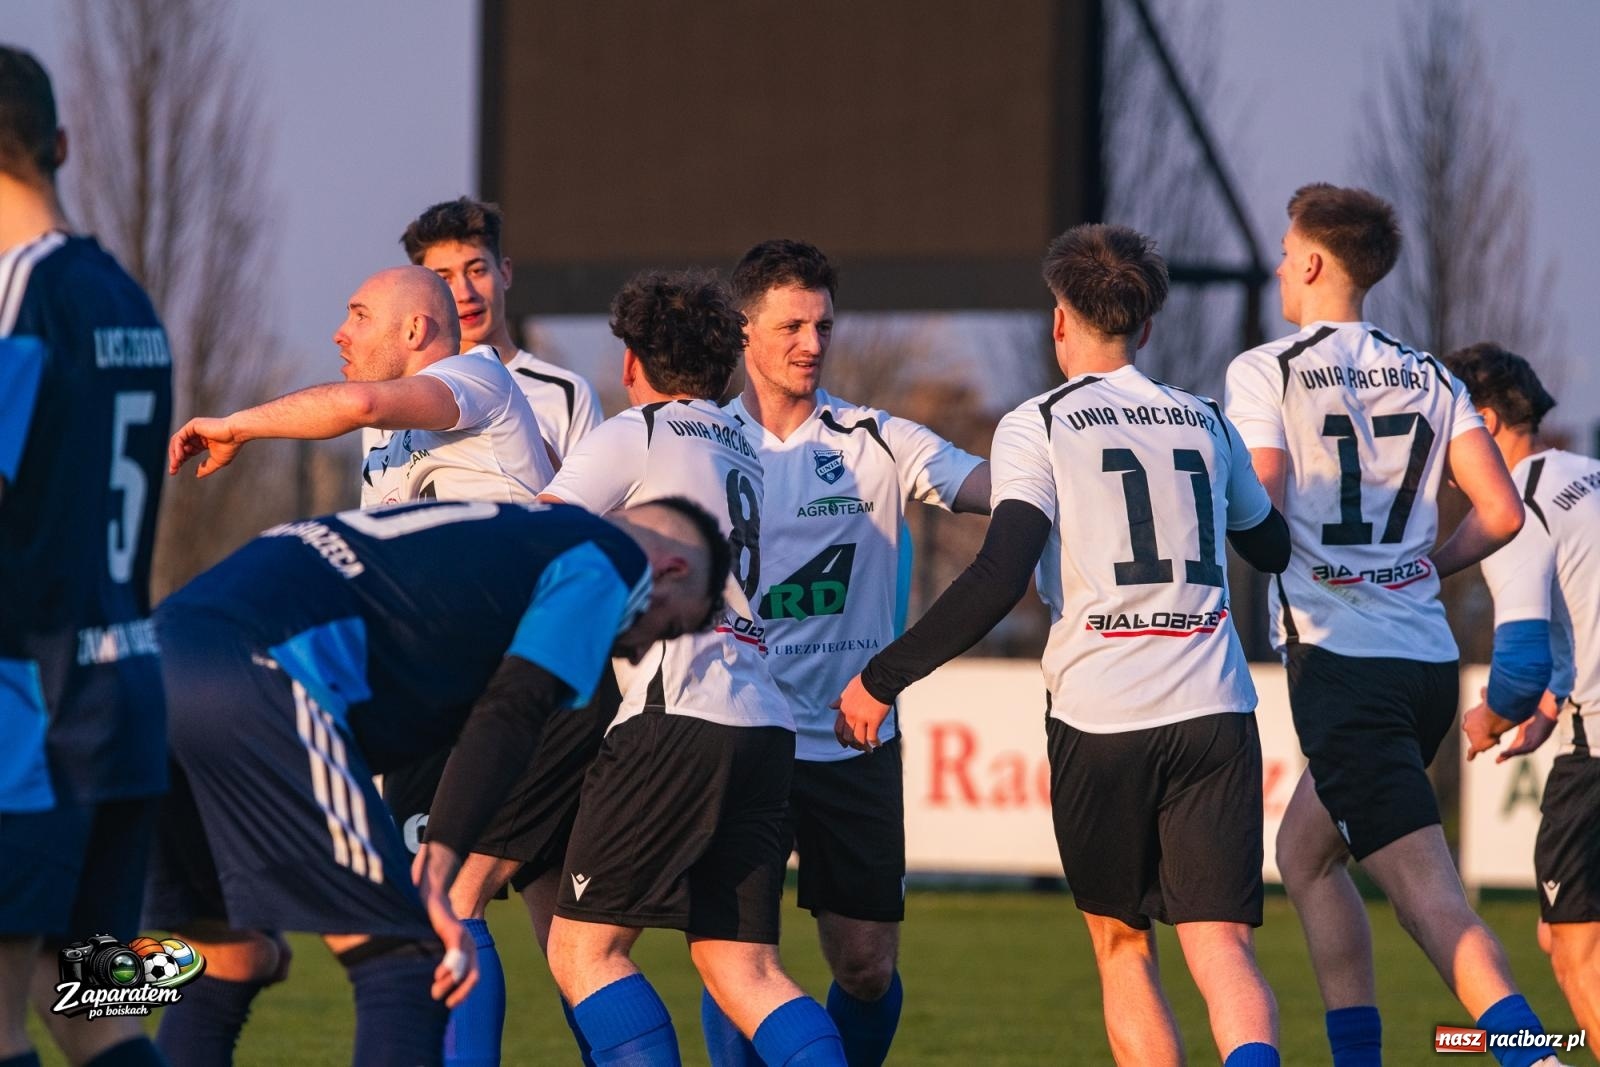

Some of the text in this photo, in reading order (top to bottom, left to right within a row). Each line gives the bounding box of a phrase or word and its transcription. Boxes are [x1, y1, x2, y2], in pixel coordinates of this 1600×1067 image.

[1300, 364, 1429, 393] UNIA RACIBÓRZ
[666, 420, 712, 440] UNIA
[1067, 404, 1217, 438] UNIA RACIBÓRZ
[819, 460, 840, 474] UNIA
[1321, 411, 1436, 546] 17
[108, 391, 156, 583] 5
[1552, 480, 1591, 511] UNIA
[1102, 448, 1225, 588] 11
[726, 468, 761, 603] 8
